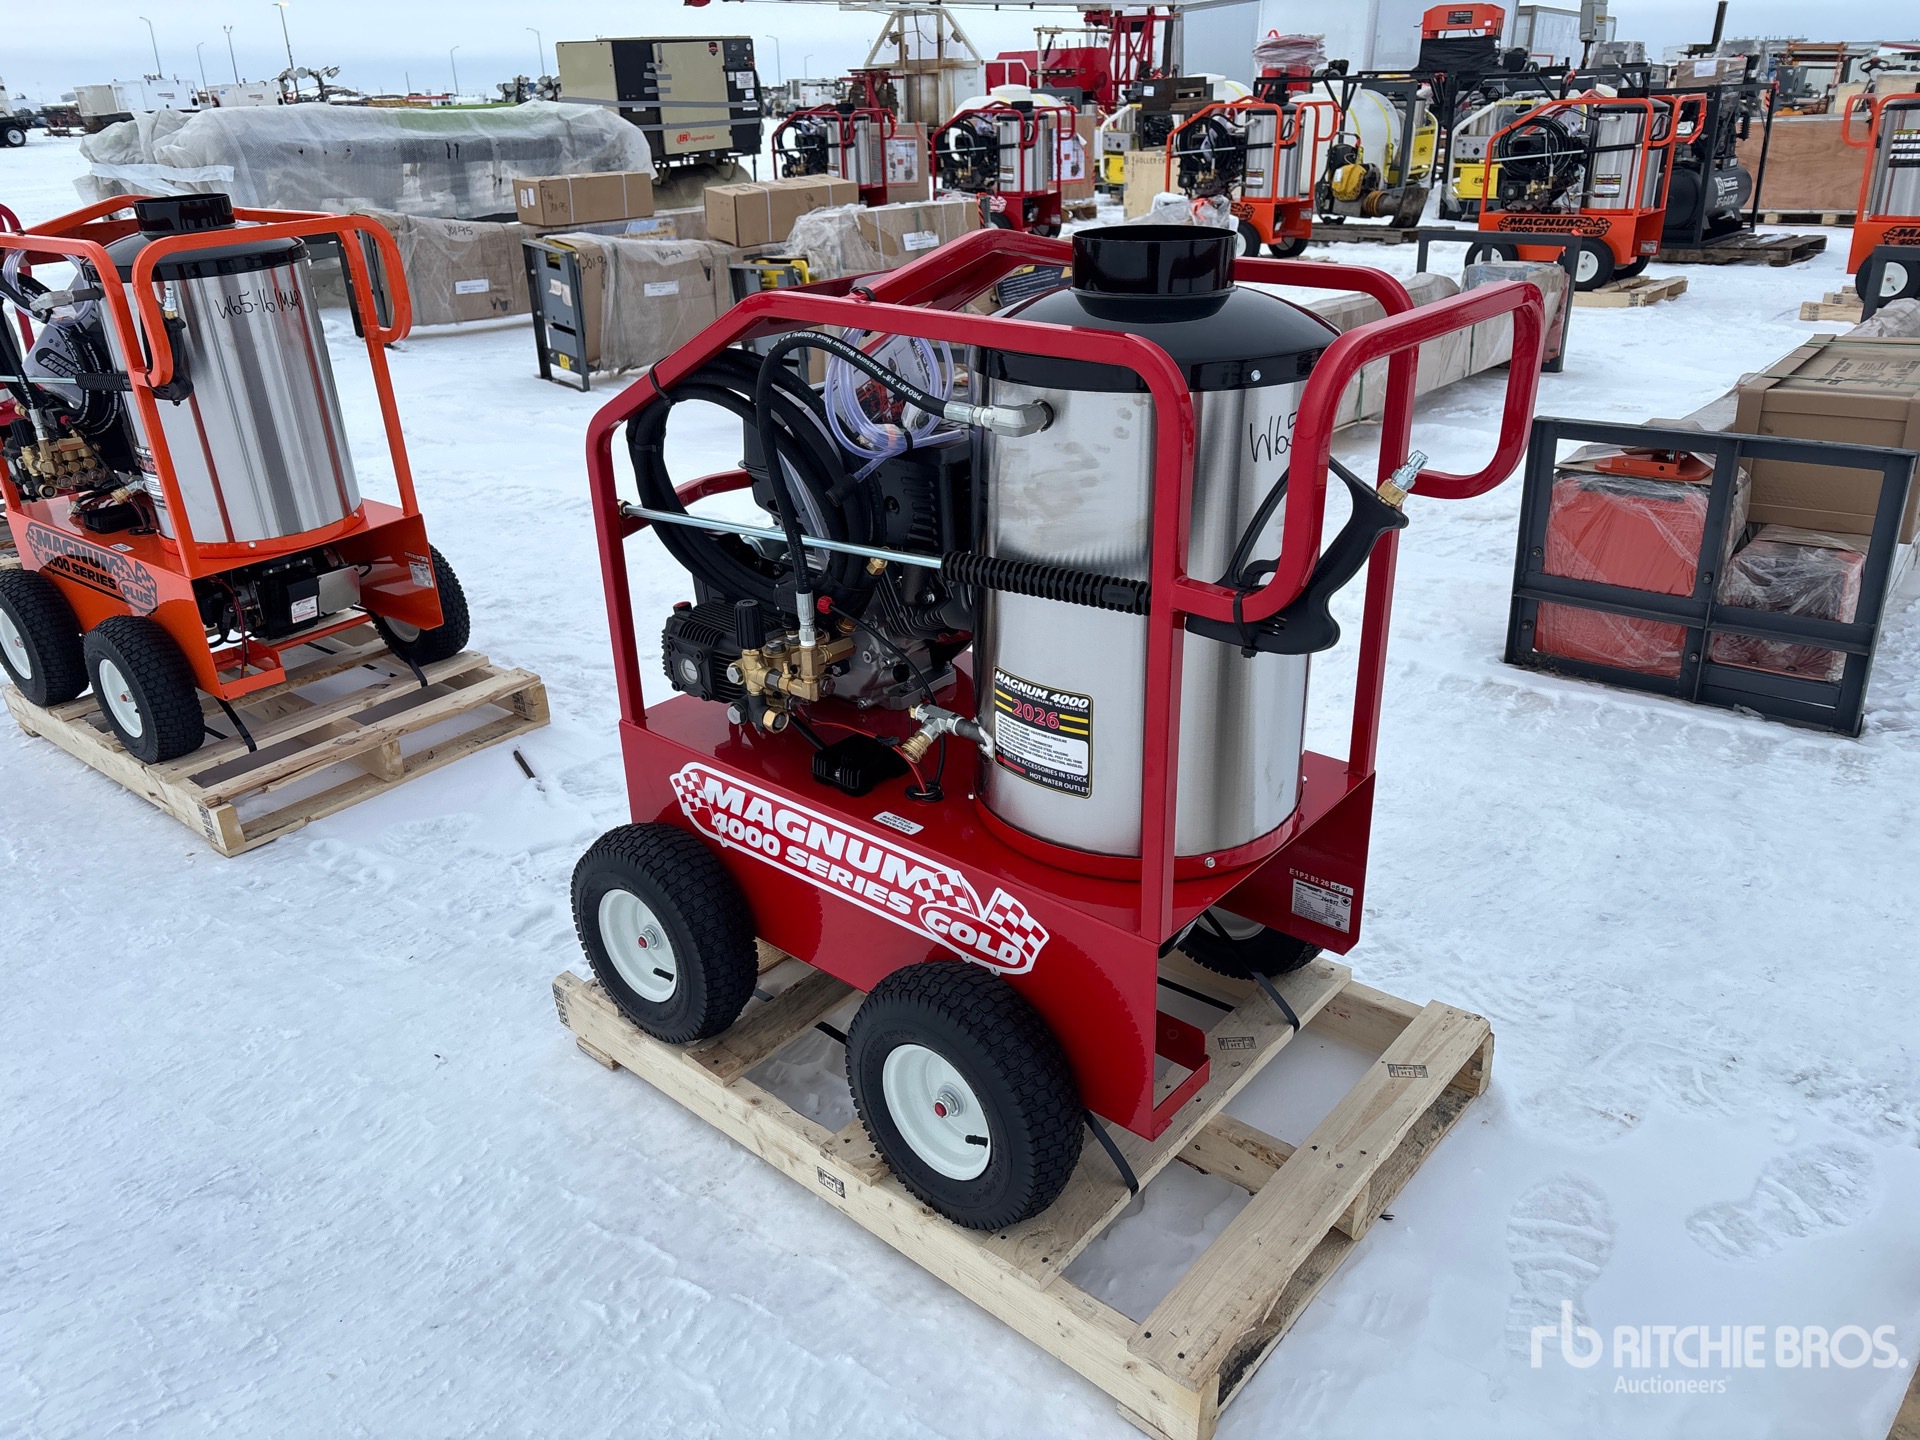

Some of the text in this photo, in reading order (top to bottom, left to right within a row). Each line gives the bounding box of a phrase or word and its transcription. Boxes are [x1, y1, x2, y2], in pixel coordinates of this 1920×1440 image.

[1510, 217, 1579, 227] MAGNUM
[816, 334, 834, 346] Hose
[833, 340, 858, 359] Washer
[857, 354, 884, 376] Pressure
[896, 383, 923, 401] PROJET
[37, 528, 116, 573] MAGNUM
[71, 563, 117, 590] SERIES
[123, 585, 151, 607] PLUS
[995, 671, 1089, 708] MAGNUM 4000
[1004, 684, 1022, 696] WATER
[1022, 692, 1053, 706] PRESSURE
[1055, 703, 1088, 713] WASHERS
[1012, 698, 1060, 729] 2026
[1003, 748, 1017, 761] PARTS
[1021, 758, 1058, 776] ACCESSORIES
[1066, 773, 1088, 783] STOCK
[1029, 772, 1089, 794] HOT WATER OUTLET
[703, 776, 928, 894] MAGNUM
[711, 812, 914, 915] 4000 SERIES
[925, 911, 1022, 967] GOLD
